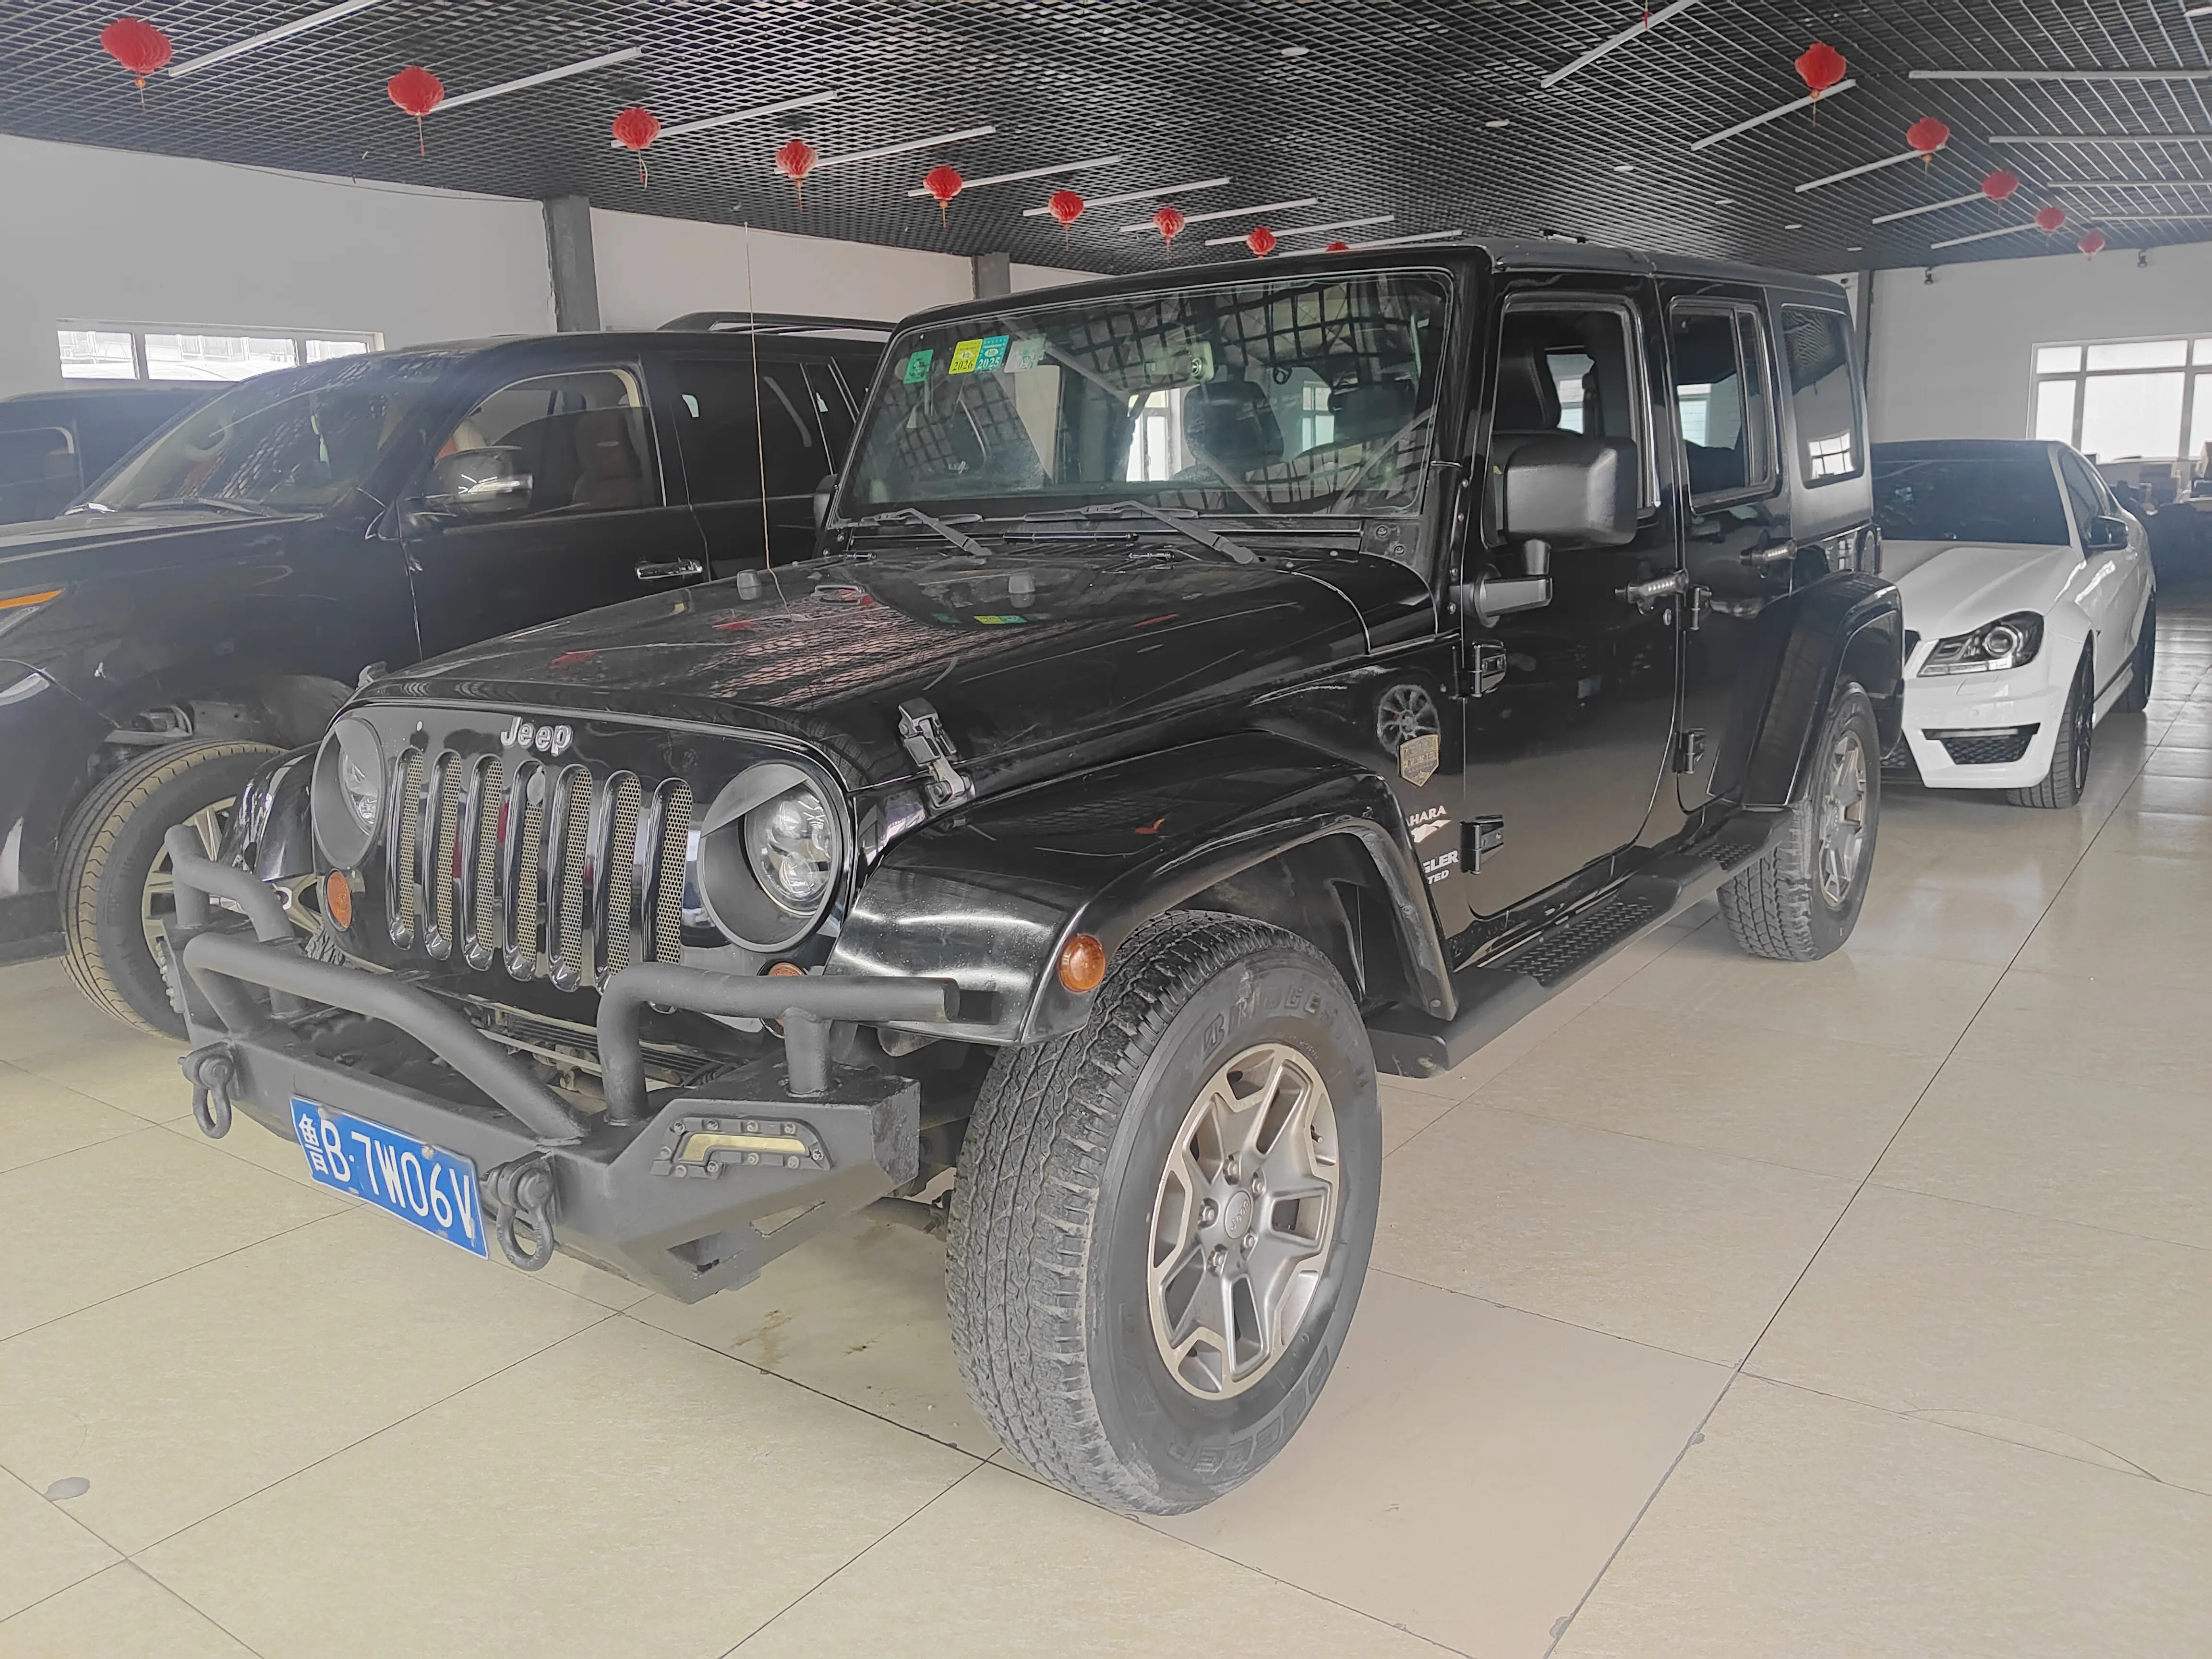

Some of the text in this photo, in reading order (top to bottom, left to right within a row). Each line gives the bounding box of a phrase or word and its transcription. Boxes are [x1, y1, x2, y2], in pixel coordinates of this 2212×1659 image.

[952, 359, 974, 371] 2026
[976, 357, 1001, 369] 2025
[500, 716, 574, 757] Jeep
[1406, 805, 1447, 826] HARA
